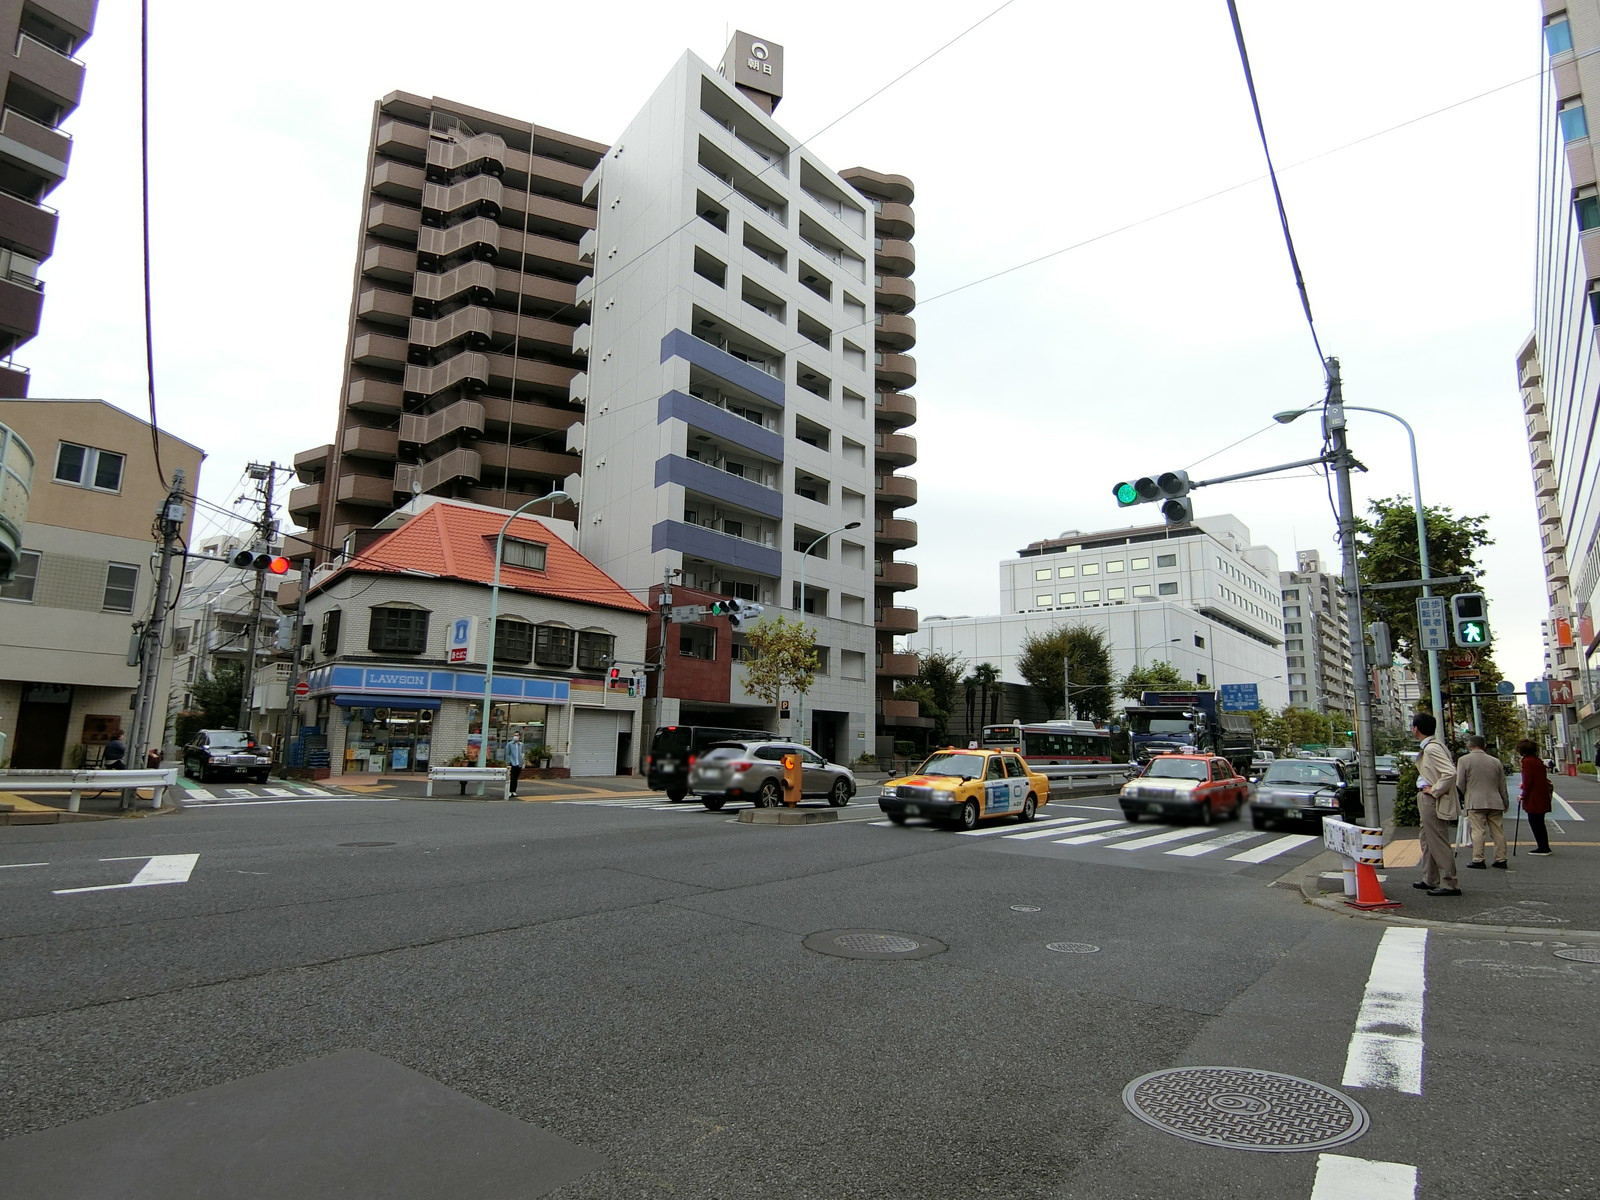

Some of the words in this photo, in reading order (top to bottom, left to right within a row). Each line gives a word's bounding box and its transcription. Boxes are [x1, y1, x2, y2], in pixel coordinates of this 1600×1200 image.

[747, 58, 772, 76] 朝日
[1421, 601, 1431, 627] 自転車
[1430, 600, 1441, 627] 歩行者
[1429, 628, 1438, 646] 専用
[369, 673, 425, 685] LAWSON
